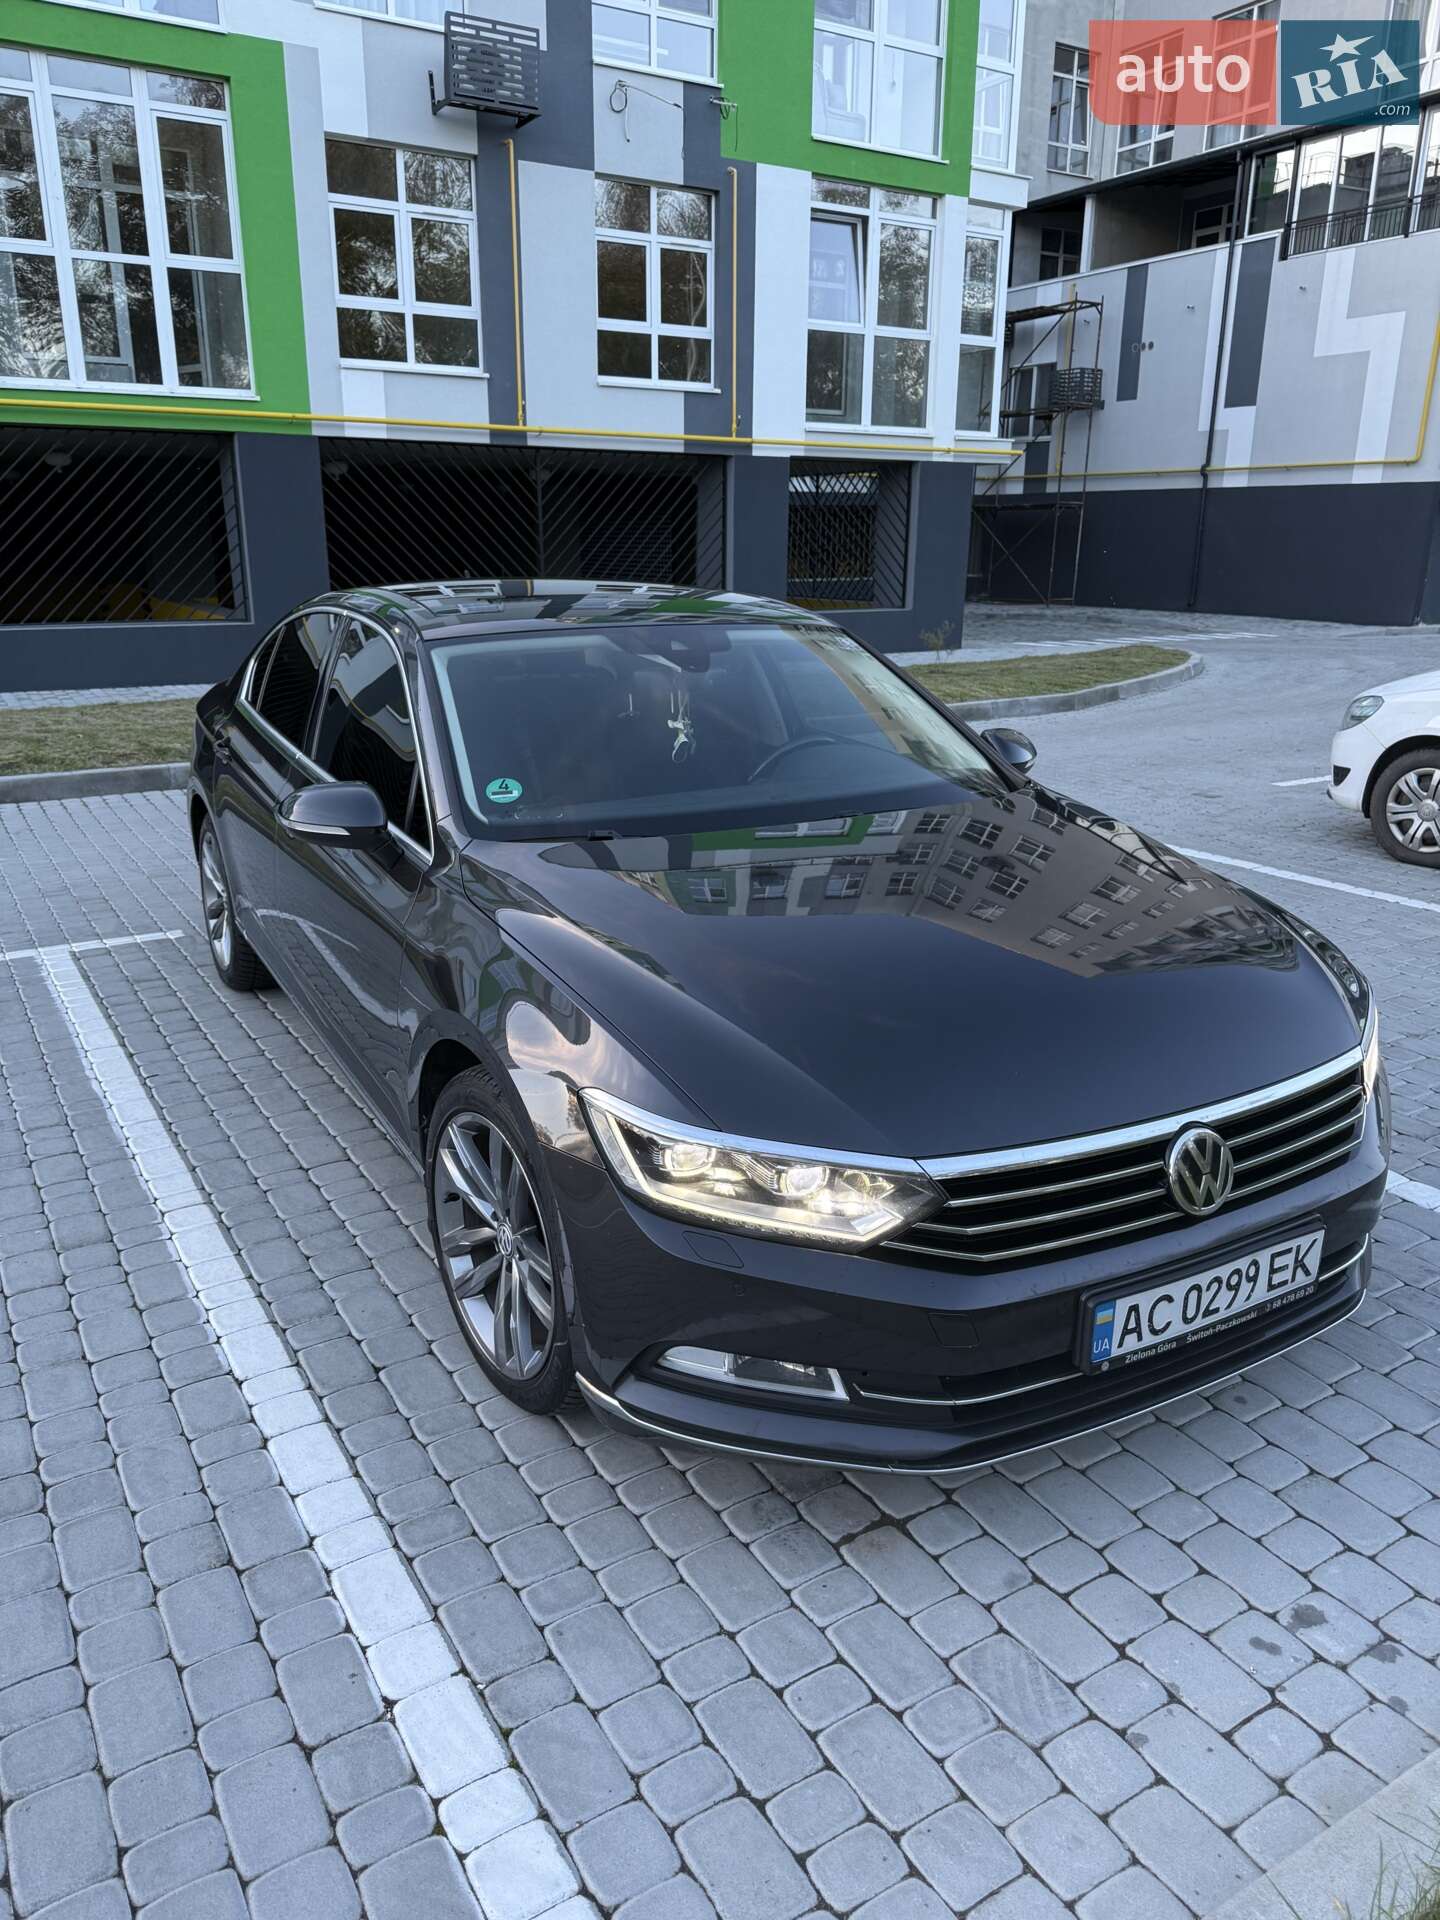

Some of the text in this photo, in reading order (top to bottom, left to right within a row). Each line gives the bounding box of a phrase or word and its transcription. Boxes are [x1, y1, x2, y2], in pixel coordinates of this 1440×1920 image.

[499, 779, 509, 790] 4
[1117, 1238, 1318, 1349] AC 0299 EK
[1093, 1339, 1110, 1353] UA
[1125, 1348, 1156, 1364] Zielona
[1157, 1341, 1177, 1353] Góra
